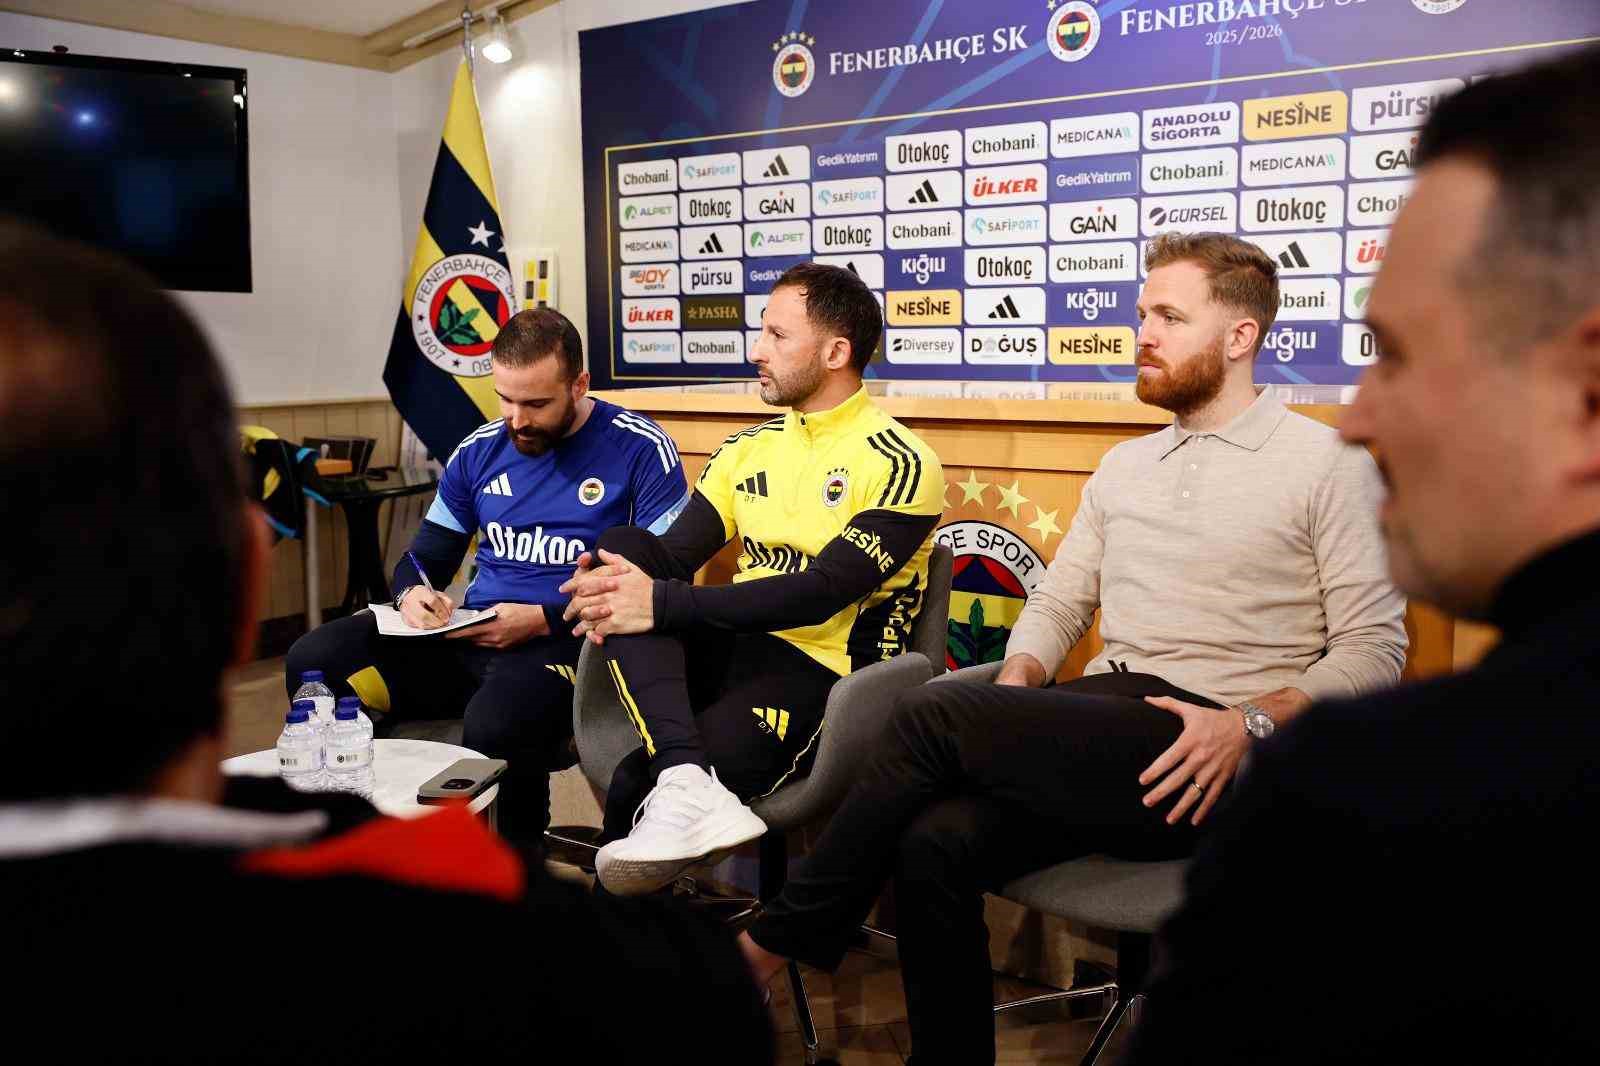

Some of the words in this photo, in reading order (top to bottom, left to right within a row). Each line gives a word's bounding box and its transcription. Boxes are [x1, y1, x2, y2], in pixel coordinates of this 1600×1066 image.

[1205, 24, 1284, 46] 2025/2026
[829, 35, 985, 75] FENERBAHÇE
[992, 25, 1028, 52] SK
[1369, 90, 1440, 125] pürs
[1151, 110, 1232, 127] ANADOLU
[972, 134, 1036, 154] Chobani
[1057, 128, 1122, 144] MEDICANA
[897, 142, 950, 165] Otokoç
[1150, 160, 1224, 181] Chobani
[1249, 156, 1327, 172] MEDICANA
[624, 169, 669, 185] Chobani
[972, 175, 1038, 198] ÜLKER
[640, 206, 672, 216] ALPET
[689, 199, 732, 219] Otokoç
[1169, 206, 1228, 224] GÜRSEL
[1256, 198, 1326, 223] Otokoç
[768, 233, 803, 243] ALPET
[824, 225, 872, 247] Otokoç
[892, 222, 951, 239] Chobani
[625, 241, 667, 252] MEDICANA
[977, 256, 1033, 280] Otokoç
[1056, 254, 1124, 271] Chobani
[416, 258, 506, 304] FENERBAHÇE
[691, 267, 732, 290] pürsu
[628, 306, 673, 323] ÜLKER
[699, 306, 738, 320] PASHA
[418, 329, 446, 361] 1907
[687, 341, 736, 355] Chobani
[904, 338, 954, 352] Diversey
[976, 529, 1035, 577] SPOR
